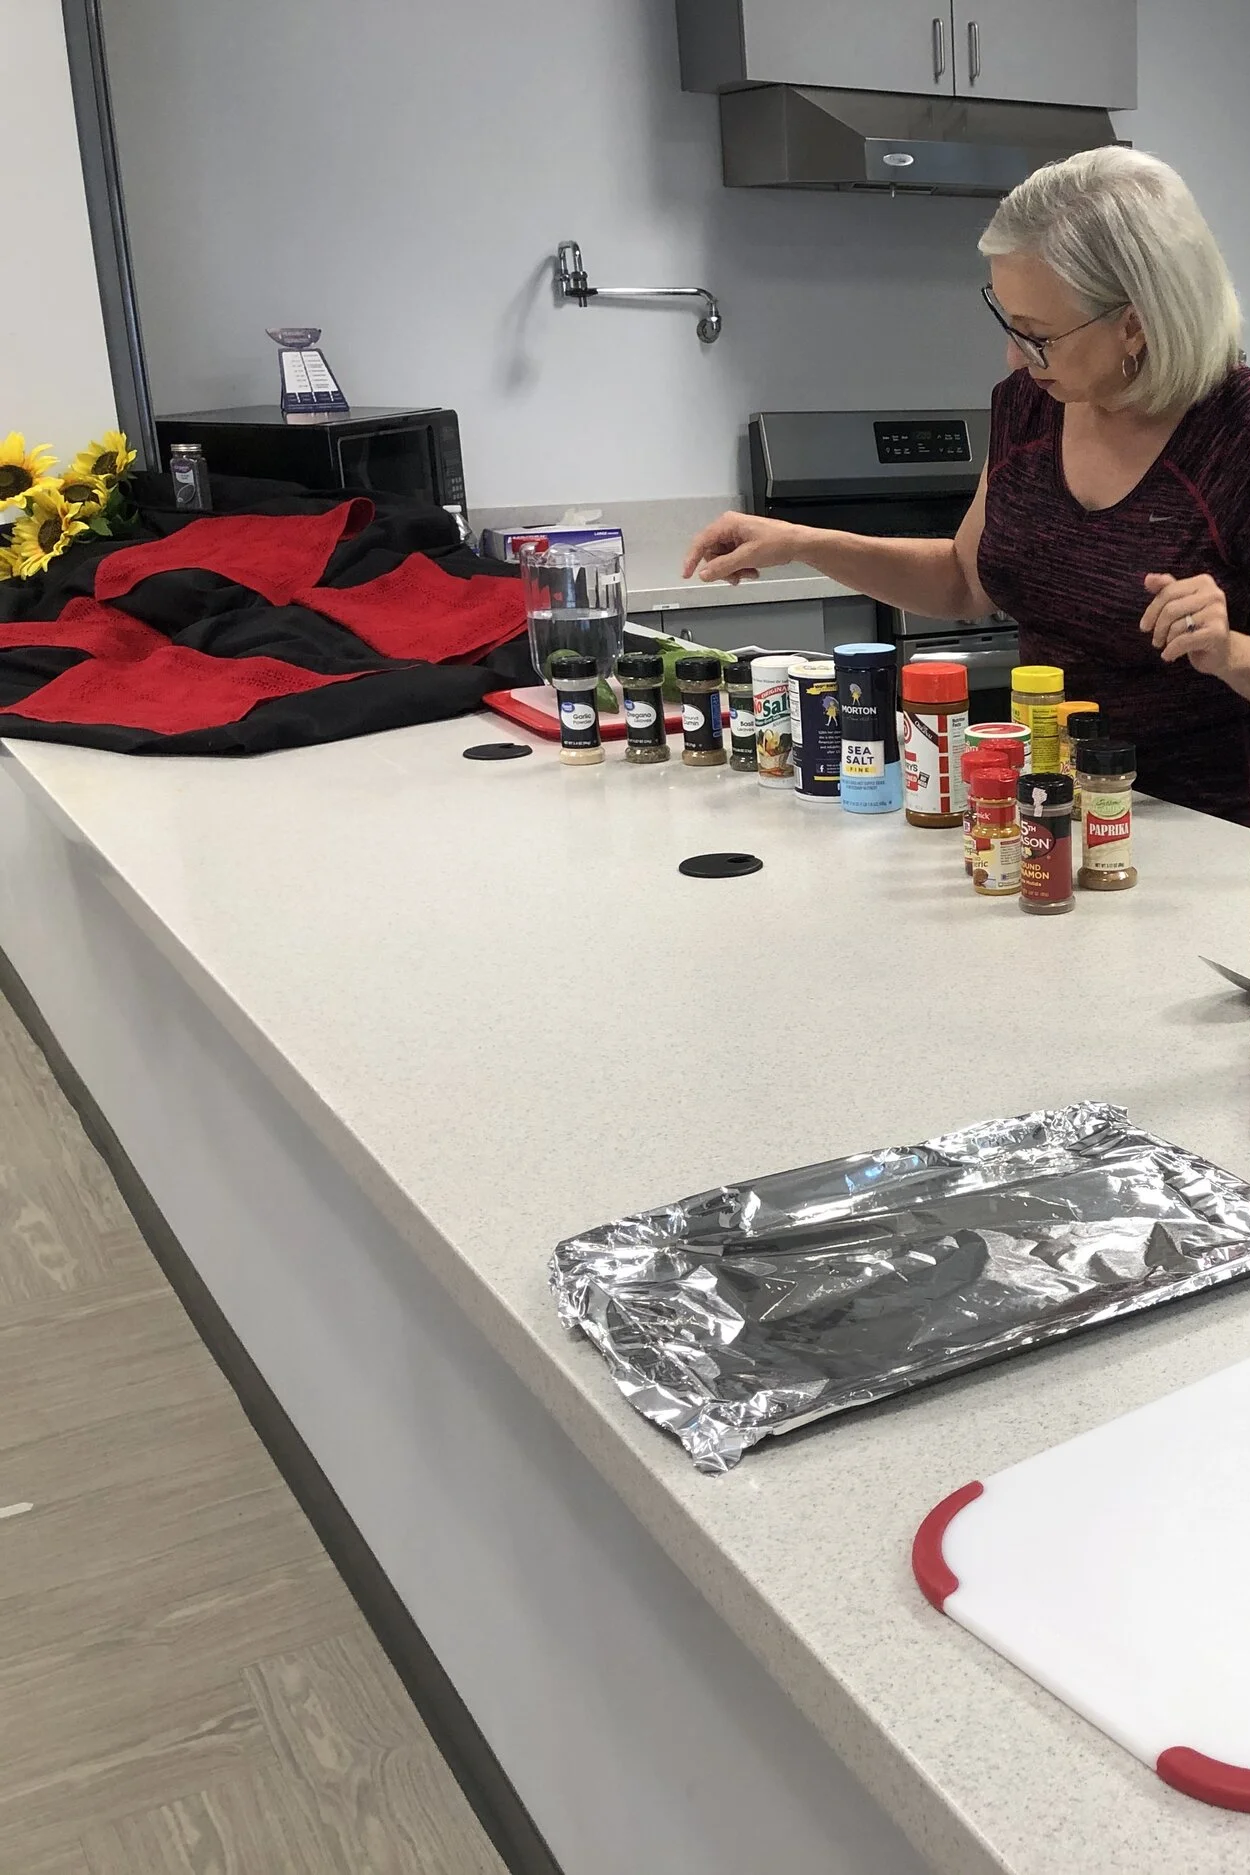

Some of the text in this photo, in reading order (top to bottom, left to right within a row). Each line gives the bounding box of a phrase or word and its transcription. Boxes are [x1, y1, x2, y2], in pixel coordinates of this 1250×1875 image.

[760, 685, 789, 699] ORIGINA
[841, 705, 877, 715] MORTON
[847, 745, 872, 755] SEA
[846, 756, 875, 766] SALT
[1089, 822, 1130, 837] PAPRIKA
[1020, 837, 1051, 850] ASON
